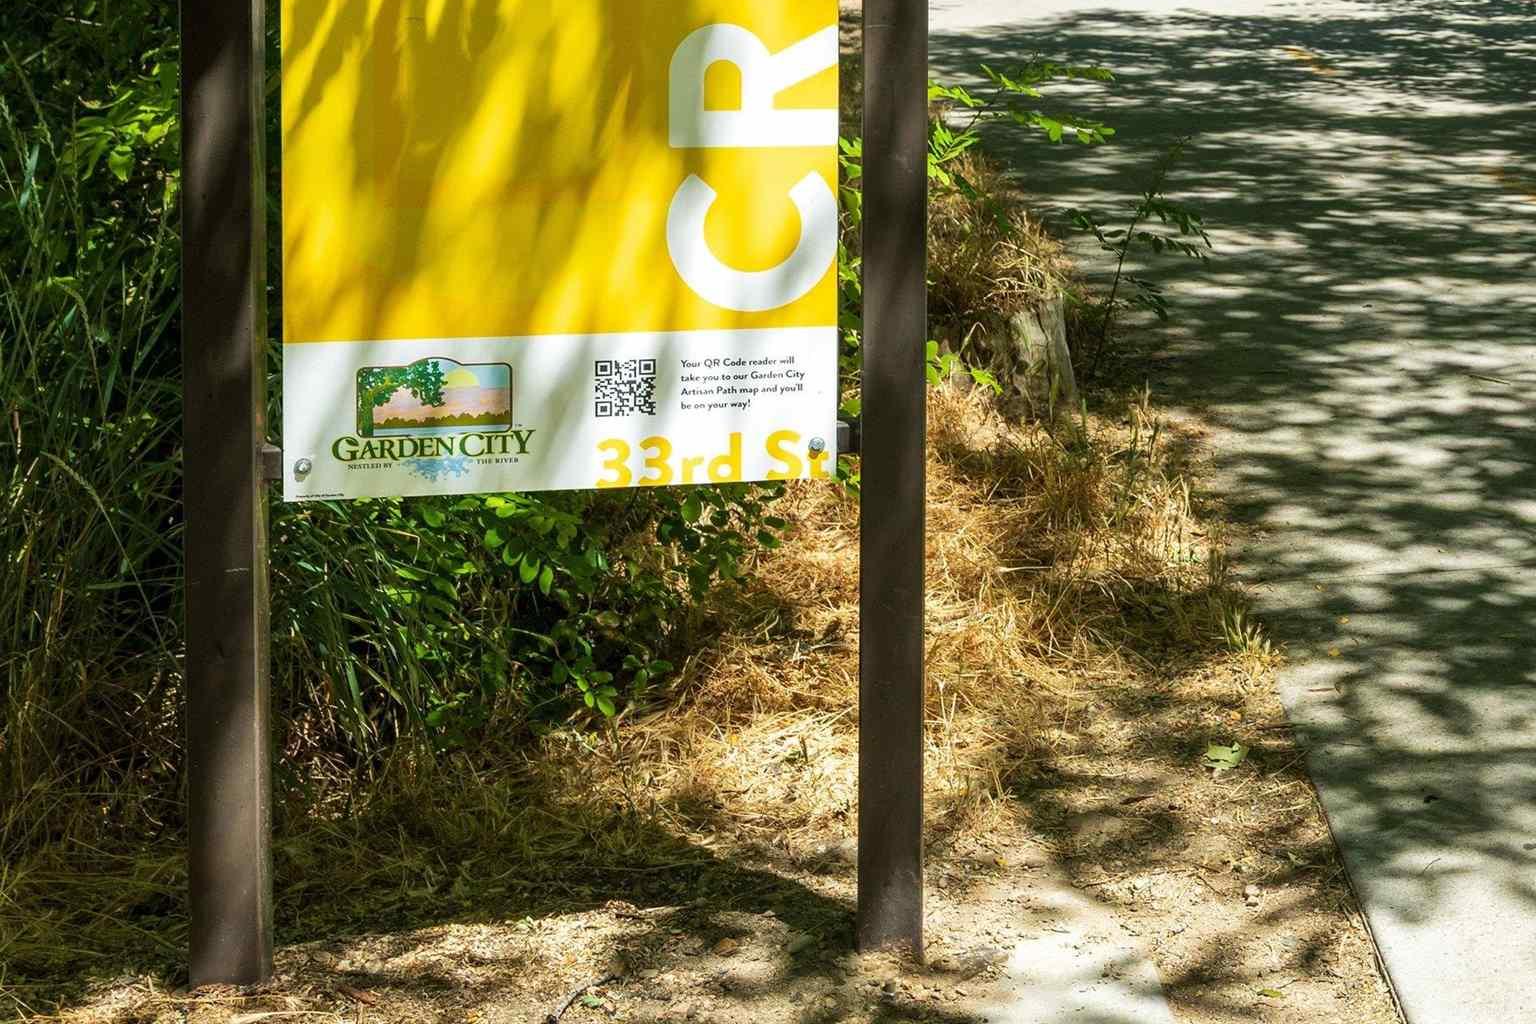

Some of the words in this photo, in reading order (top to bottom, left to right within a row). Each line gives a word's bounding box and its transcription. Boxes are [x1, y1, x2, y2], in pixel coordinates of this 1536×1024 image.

[681, 359, 701, 368] Your
[704, 358, 720, 368] QR
[723, 357, 747, 367] Code
[749, 356, 777, 366] reader
[779, 356, 795, 365] will
[681, 374, 700, 382] take
[703, 375, 719, 384] you
[721, 373, 731, 381] to
[750, 371, 784, 380] Garden
[785, 369, 805, 381] City
[681, 387, 714, 396] Artisan
[716, 385, 738, 395] Path
[739, 386, 759, 396] map
[761, 384, 778, 393] and
[779, 383, 804, 395] you'll
[681, 401, 692, 410] be
[708, 402, 729, 411] your
[730, 399, 751, 410] way!
[331, 436, 454, 461] GARDEN
[459, 429, 536, 457] CITY
[347, 463, 382, 471] NESTLED
[594, 431, 743, 490] 33rd
